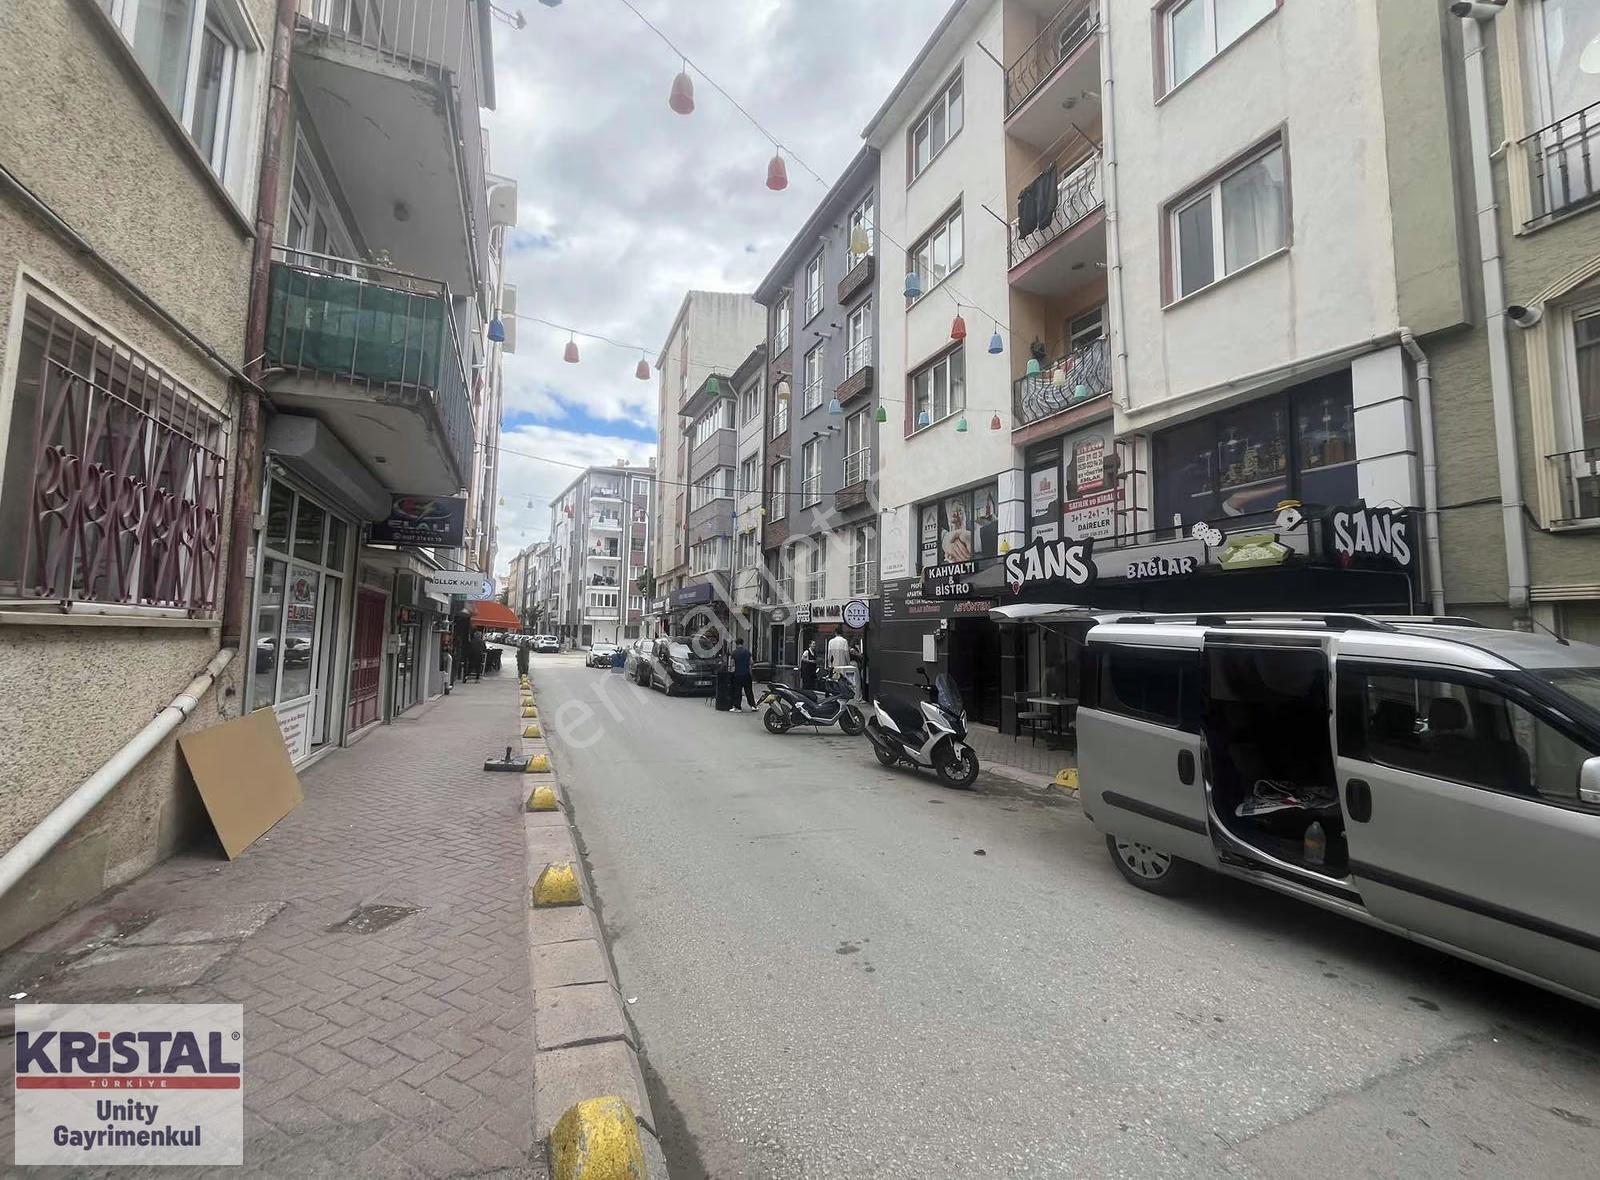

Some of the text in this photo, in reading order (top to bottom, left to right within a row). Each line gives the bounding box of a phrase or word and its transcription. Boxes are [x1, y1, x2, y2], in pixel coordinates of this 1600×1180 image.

[1071, 512, 1082, 522] 3+1
[1088, 509, 1100, 519] 2+1
[1078, 519, 1110, 531] DAİRELER
[929, 562, 975, 579] KAHVALTI
[948, 575, 955, 585] &
[935, 583, 970, 597] BİSTRO
